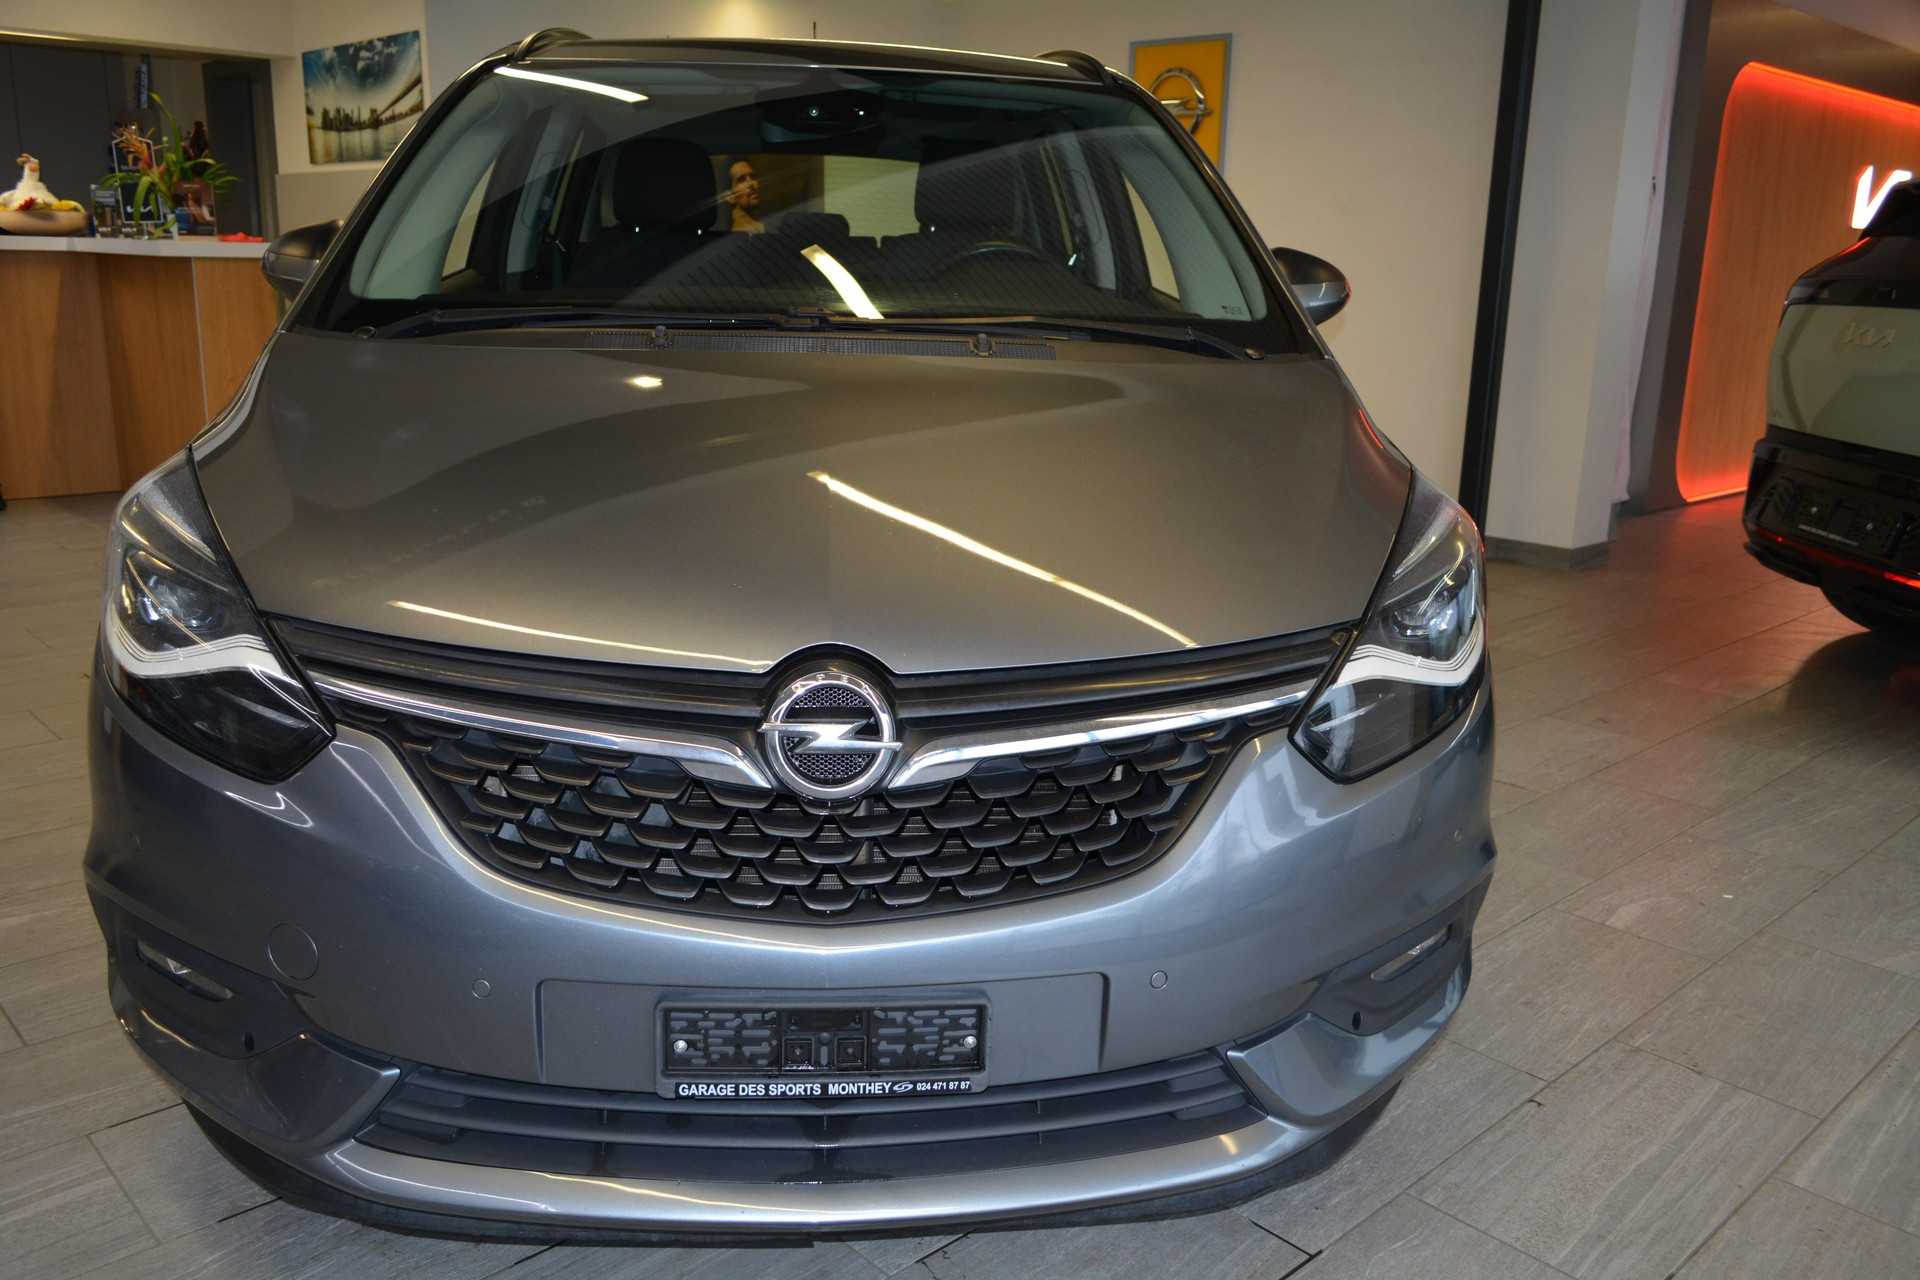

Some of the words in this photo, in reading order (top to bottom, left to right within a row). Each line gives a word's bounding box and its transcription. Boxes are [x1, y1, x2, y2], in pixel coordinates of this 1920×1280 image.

[678, 1084, 736, 1096] GARAGE
[739, 1084, 766, 1096] DES
[768, 1083, 822, 1096] SPORTS
[828, 1082, 892, 1095] MONTHEY
[916, 1082, 931, 1091] 024
[933, 1082, 947, 1091] 471
[949, 1081, 958, 1090] 87
[960, 1080, 971, 1089] 87
